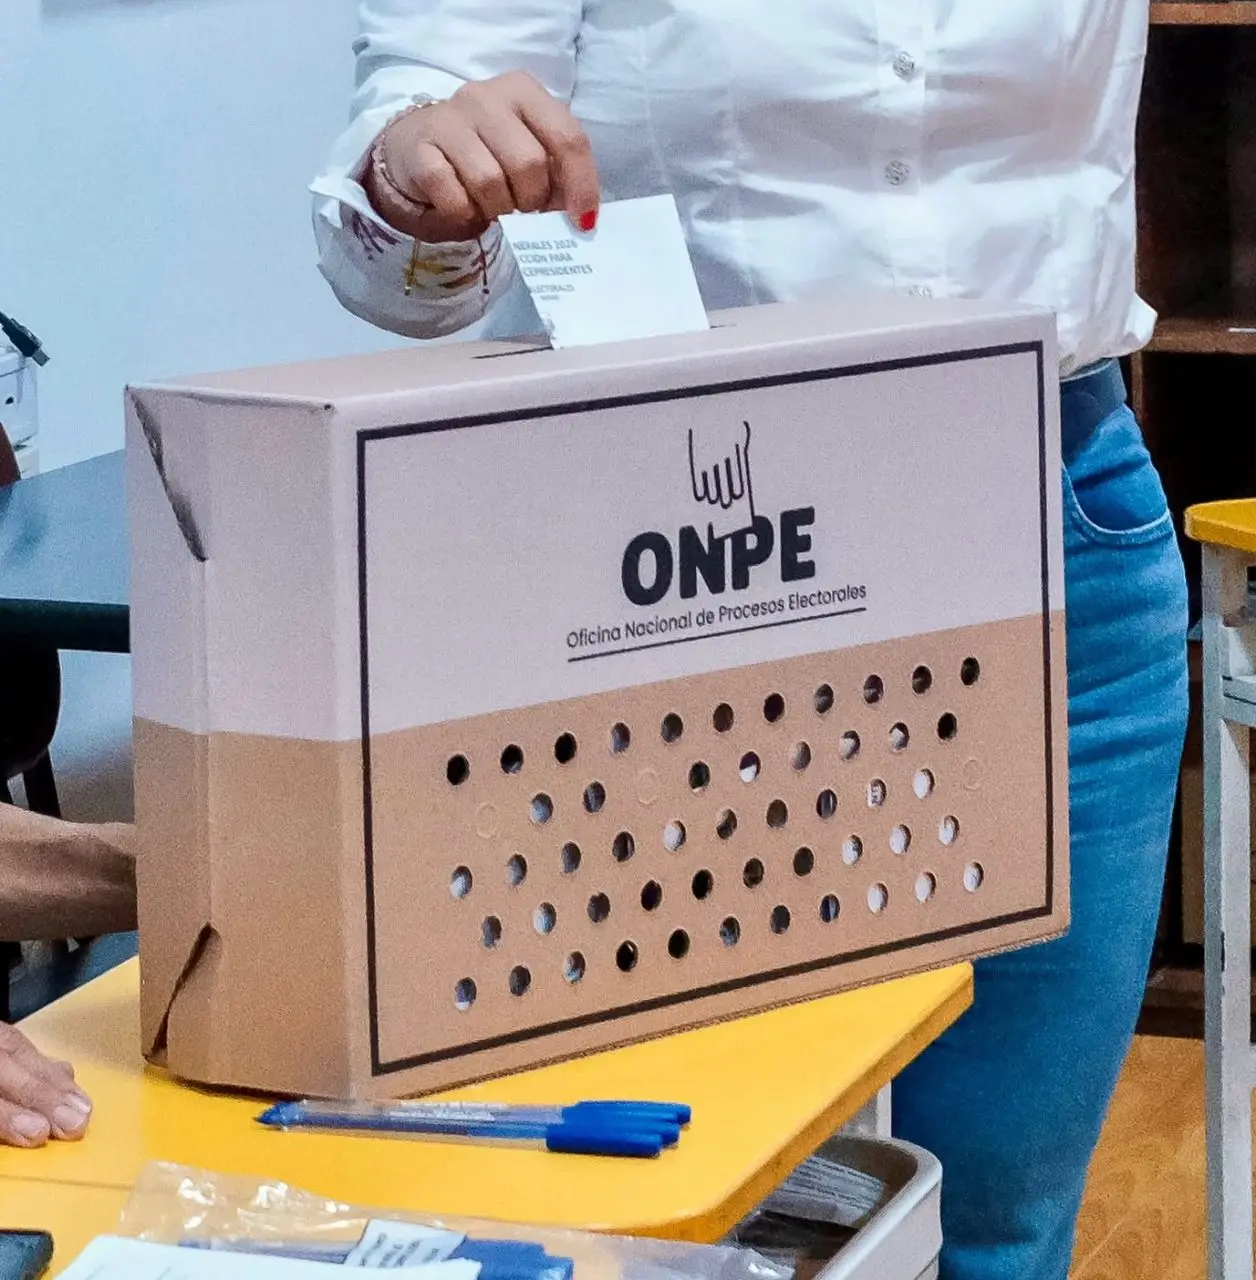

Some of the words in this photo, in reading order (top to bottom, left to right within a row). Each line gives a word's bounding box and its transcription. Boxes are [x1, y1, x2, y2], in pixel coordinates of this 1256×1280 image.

[621, 506, 816, 606] ONPE
[566, 626, 621, 648] Oficina
[624, 610, 692, 639] Nacional
[695, 608, 715, 627] de
[718, 599, 784, 621] Procesos
[788, 584, 867, 611] Electorales
